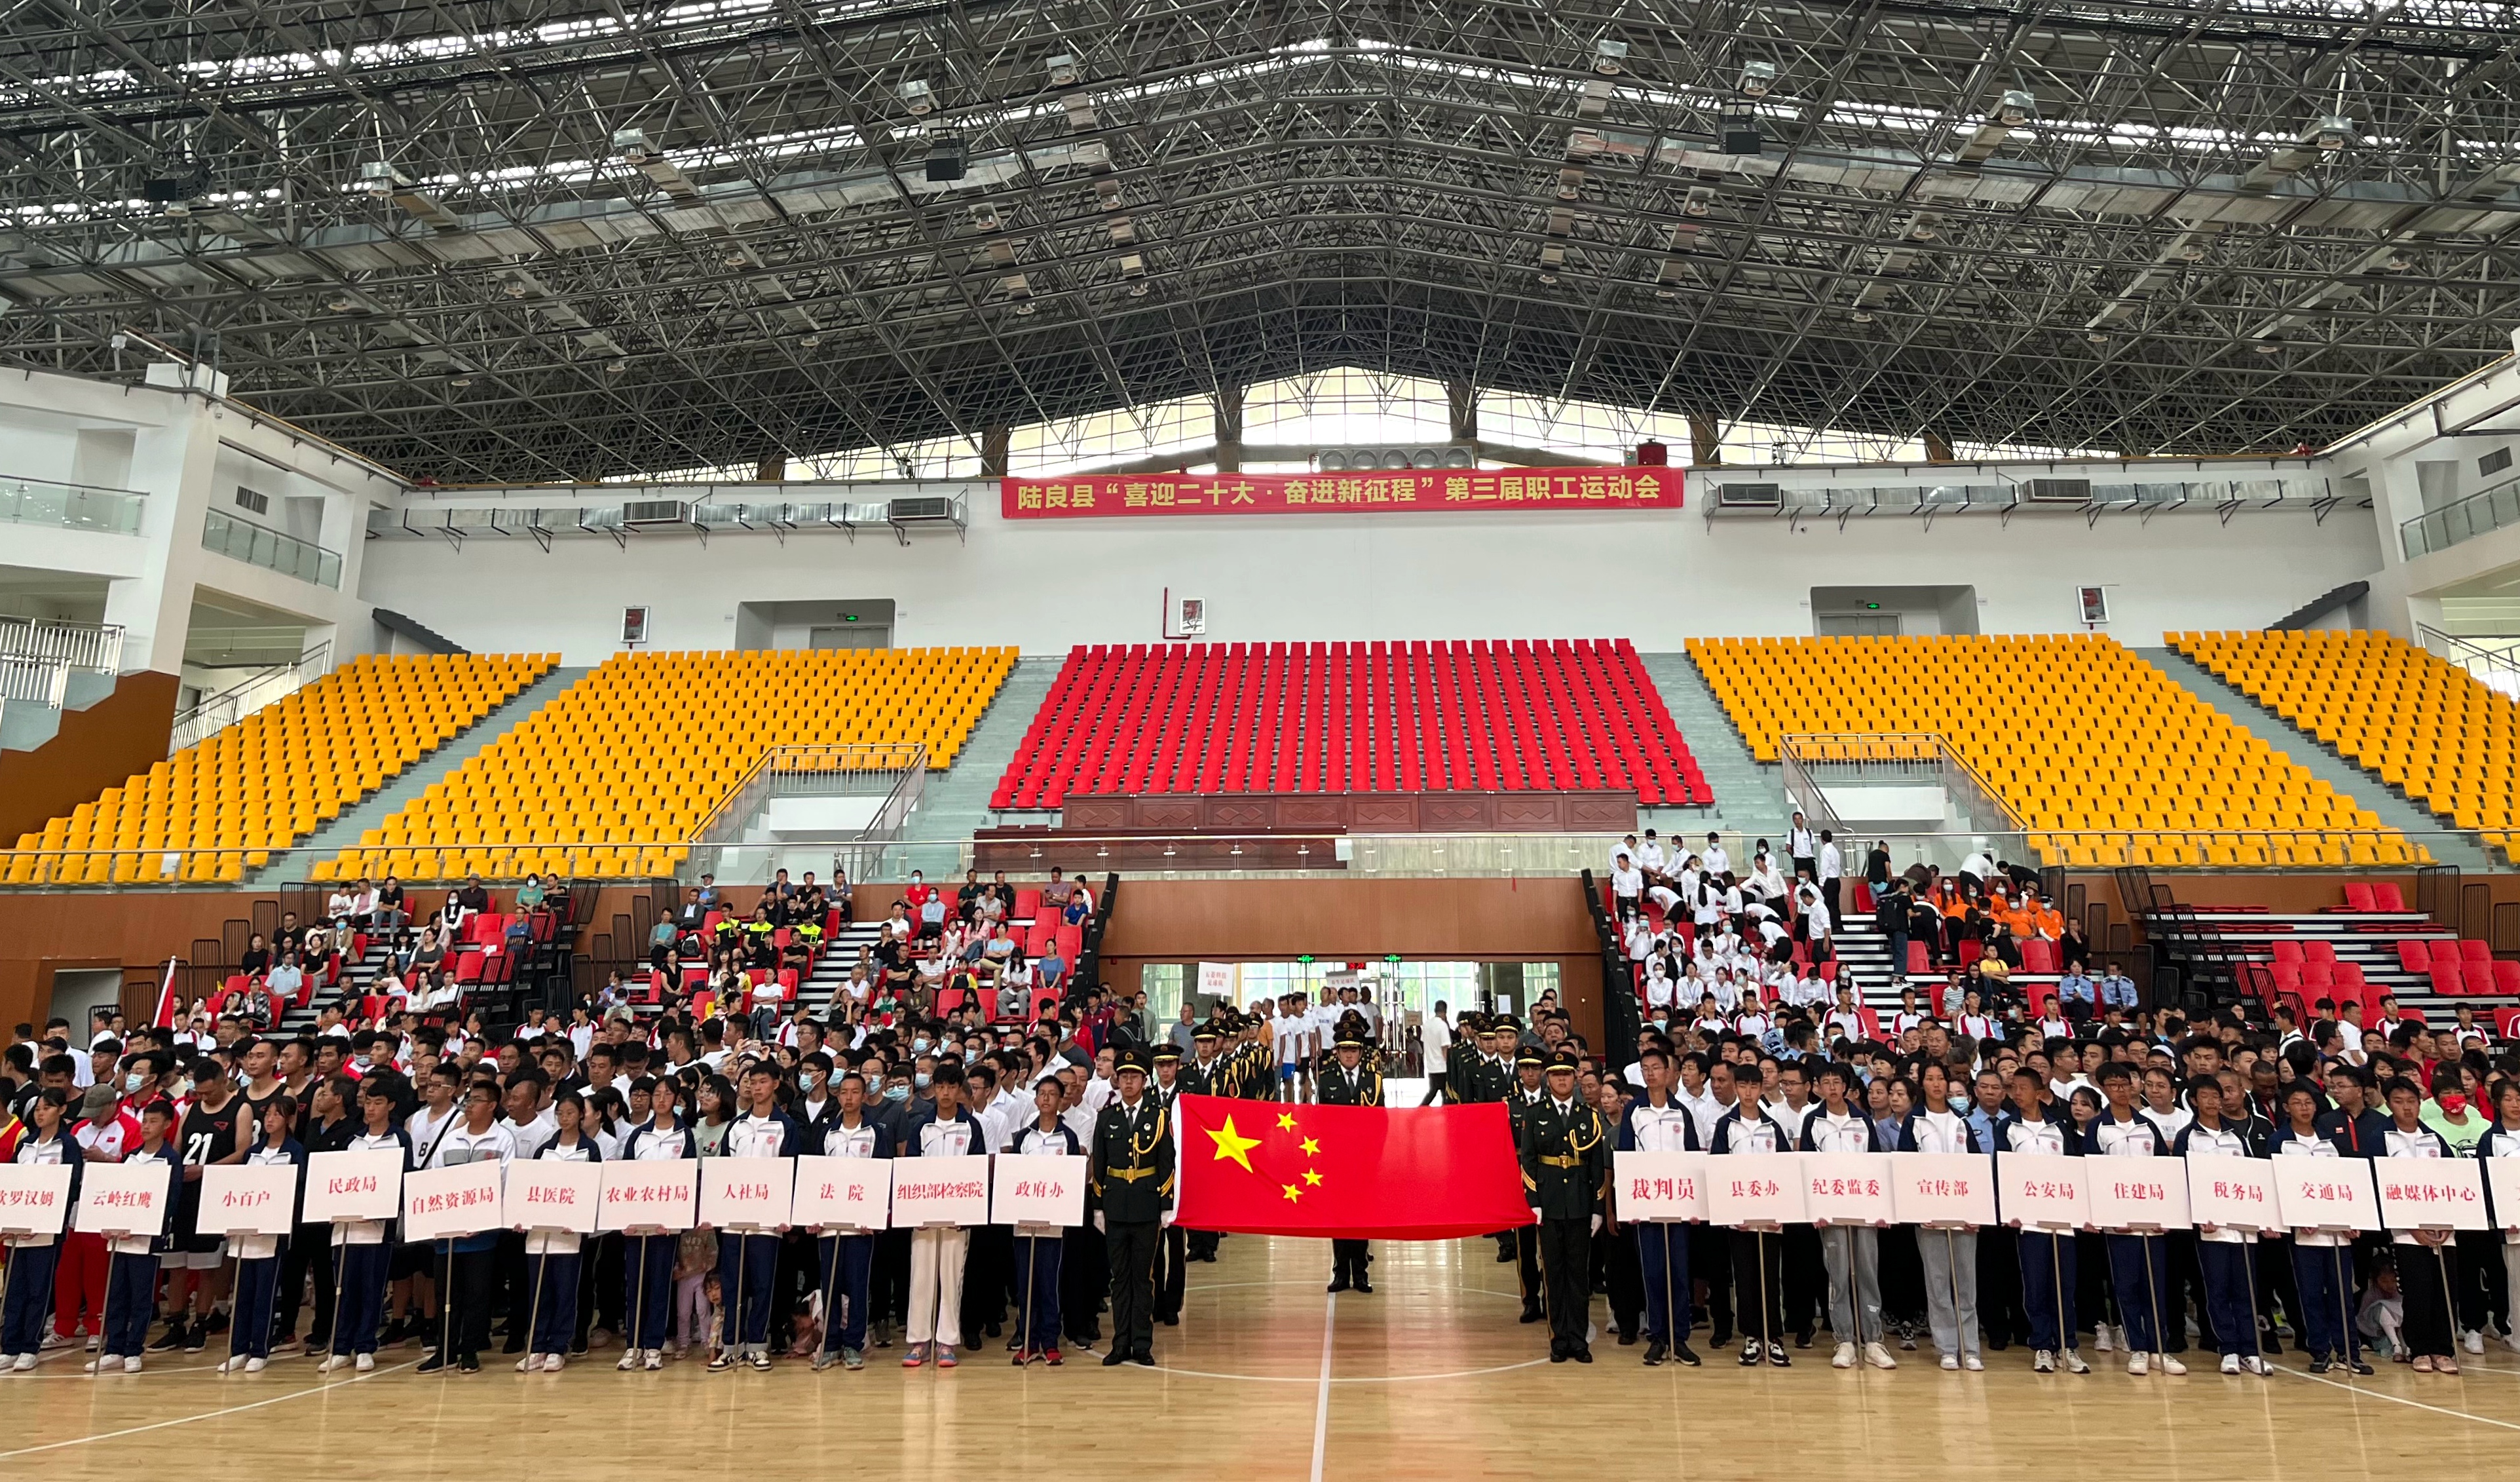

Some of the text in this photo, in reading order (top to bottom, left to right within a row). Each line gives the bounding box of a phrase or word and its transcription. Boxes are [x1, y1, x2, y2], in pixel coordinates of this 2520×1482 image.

[183, 1133, 214, 1166] 21
[418, 1142, 428, 1157] 8
[327, 1177, 377, 1194] 民政局
[607, 1185, 688, 1202] 农业农村局
[721, 1184, 769, 1200] 人社局
[896, 1181, 984, 1200] 组织部检察院
[1013, 1181, 1063, 1198] 政府办
[1630, 1178, 1695, 1201] 裁判员
[1731, 1180, 1780, 1197] 县委办
[1811, 1179, 1879, 1196] 纪委监委
[1919, 1180, 1969, 1196] 宣传部
[2024, 1181, 2075, 1200] 公安局
[2113, 1183, 2164, 1201] 住建局
[2212, 1181, 2263, 1203] 税务局
[2301, 1183, 2353, 1202] 交通局
[2384, 1185, 2476, 1202] 融媒体中心
[92, 1191, 152, 1208] 云岭红鹰
[221, 1190, 271, 1207] 小百户
[411, 1187, 494, 1215] 自然资源局
[526, 1186, 574, 1205] 县医院
